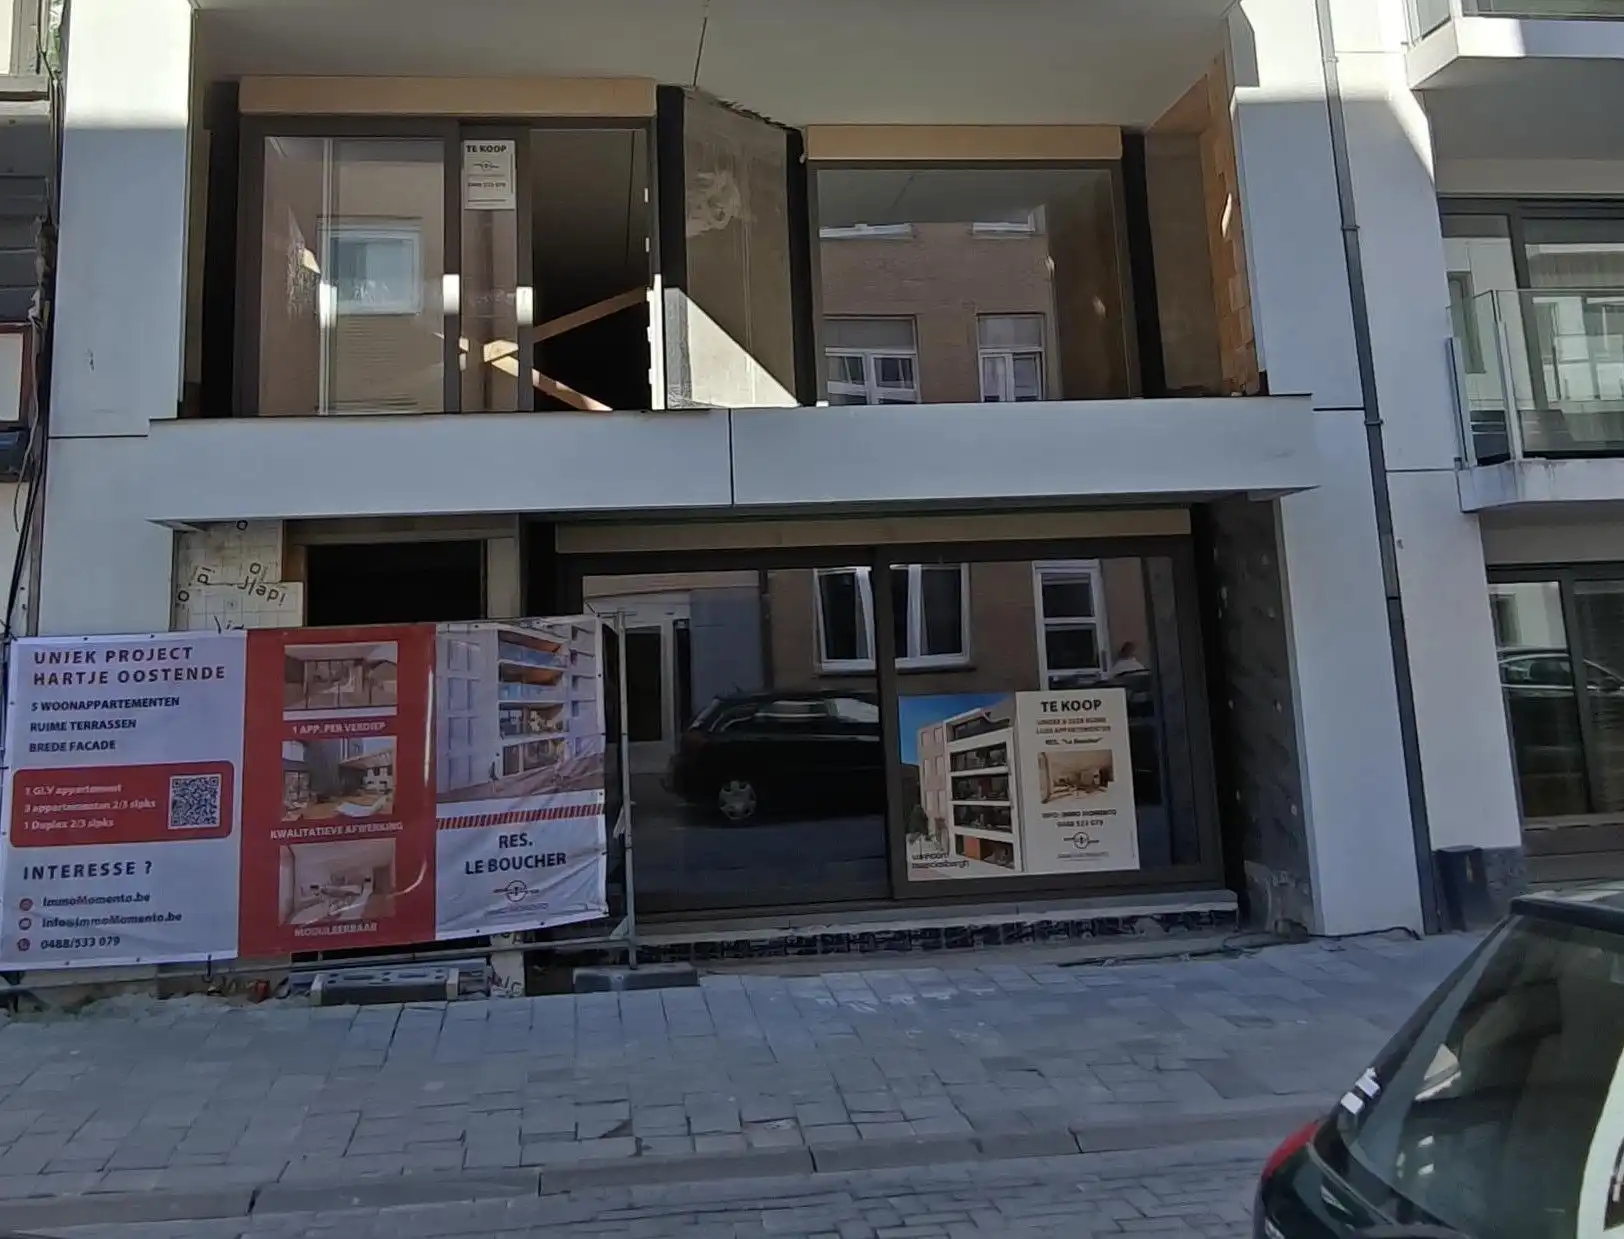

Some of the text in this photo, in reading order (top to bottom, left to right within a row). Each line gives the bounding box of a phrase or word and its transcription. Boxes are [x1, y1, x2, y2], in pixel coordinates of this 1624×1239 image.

[34, 647, 193, 664] UNIEK PROJECT
[34, 666, 226, 686] HARTJE OOSTENDE
[41, 697, 180, 711] WOONAPPARTEMENTEN
[1041, 699, 1102, 712] TE KOOP
[30, 719, 137, 732] RUIME TERRASSEN
[29, 740, 116, 753] BREDE FACADE
[499, 832, 533, 848] RES.
[23, 861, 153, 880] INTERESSE ?
[465, 852, 567, 875] LE BOUCHER
[99, 936, 121, 947] 079
